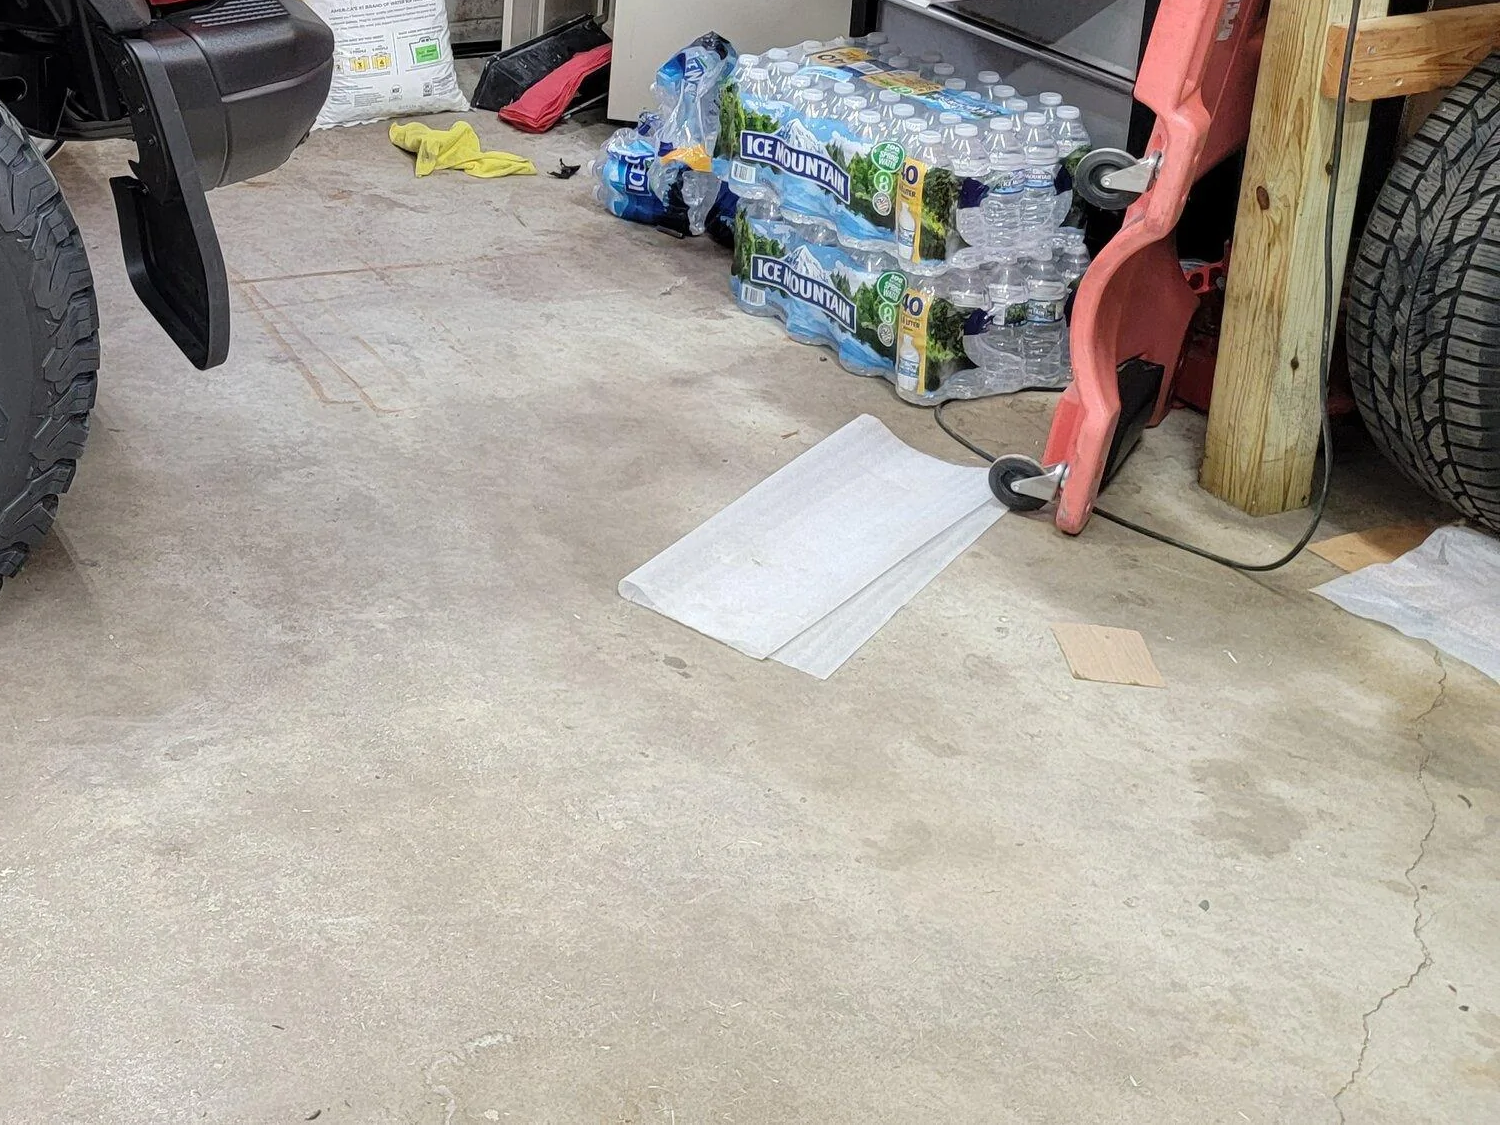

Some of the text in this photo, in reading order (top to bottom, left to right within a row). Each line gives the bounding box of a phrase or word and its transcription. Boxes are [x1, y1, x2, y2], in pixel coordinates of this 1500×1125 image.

[627, 161, 645, 192] ICE
[746, 135, 846, 197] ICE MOUNTAIN
[757, 259, 852, 326] ICE MOUNTAIN
